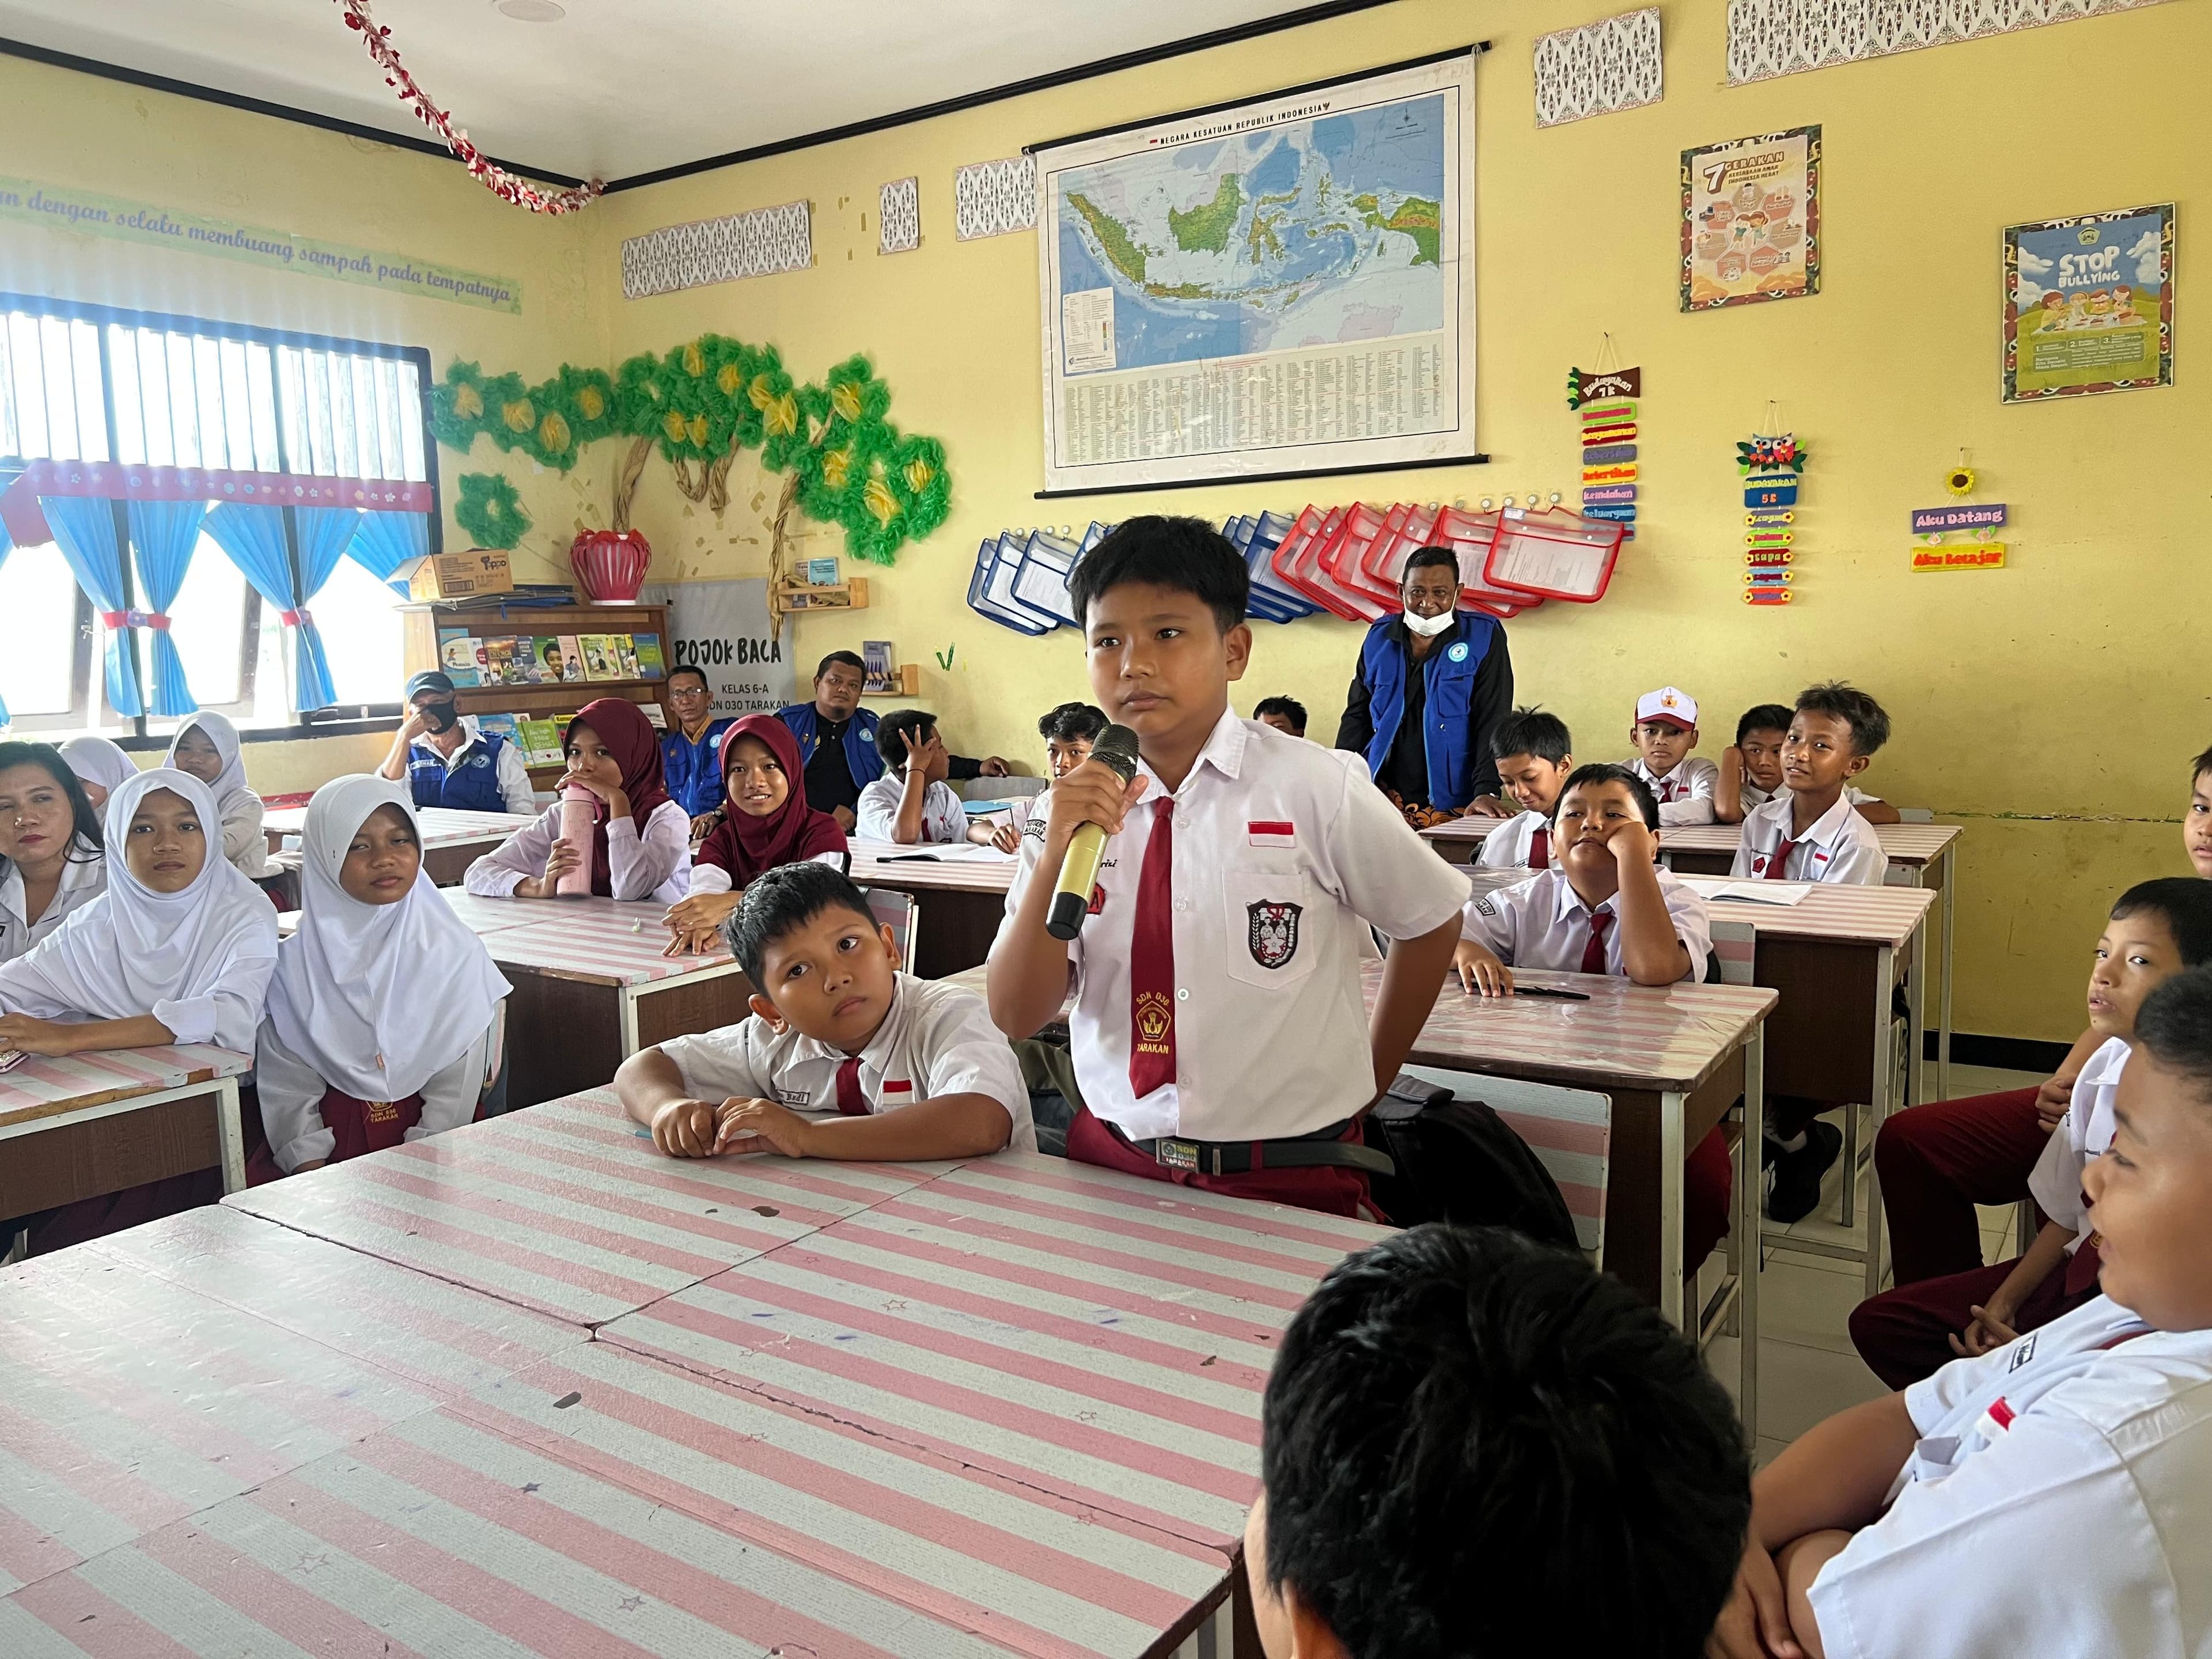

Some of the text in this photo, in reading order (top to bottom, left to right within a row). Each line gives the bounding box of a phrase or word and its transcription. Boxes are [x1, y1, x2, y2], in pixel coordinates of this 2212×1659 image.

[1160, 104, 1322, 145] NEGARA KESATUAN REPUBLIK INDONESIA
[1703, 151, 1784, 194] 7 GERAKAN
[28, 191, 110, 223] dengan
[189, 227, 294, 263] membuang
[299, 248, 373, 274] sampah
[377, 264, 422, 283] pada
[426, 271, 510, 304] tempatnya
[2059, 245, 2120, 277] STOP
[2058, 270, 2120, 288] BULLYING
[1582, 376, 1633, 397] Budayakan
[1916, 510, 2003, 527] Aku Datang
[1913, 553, 1943, 566] Aku
[737, 638, 782, 665] BACA
[722, 684, 768, 694] KELAS 6-A
[707, 700, 789, 710] DN 030 TARAKAN
[1136, 990, 1170, 1006] SDN 030
[1137, 1043, 1169, 1054] TARAKAN
[1177, 1144, 1197, 1156] SDN
